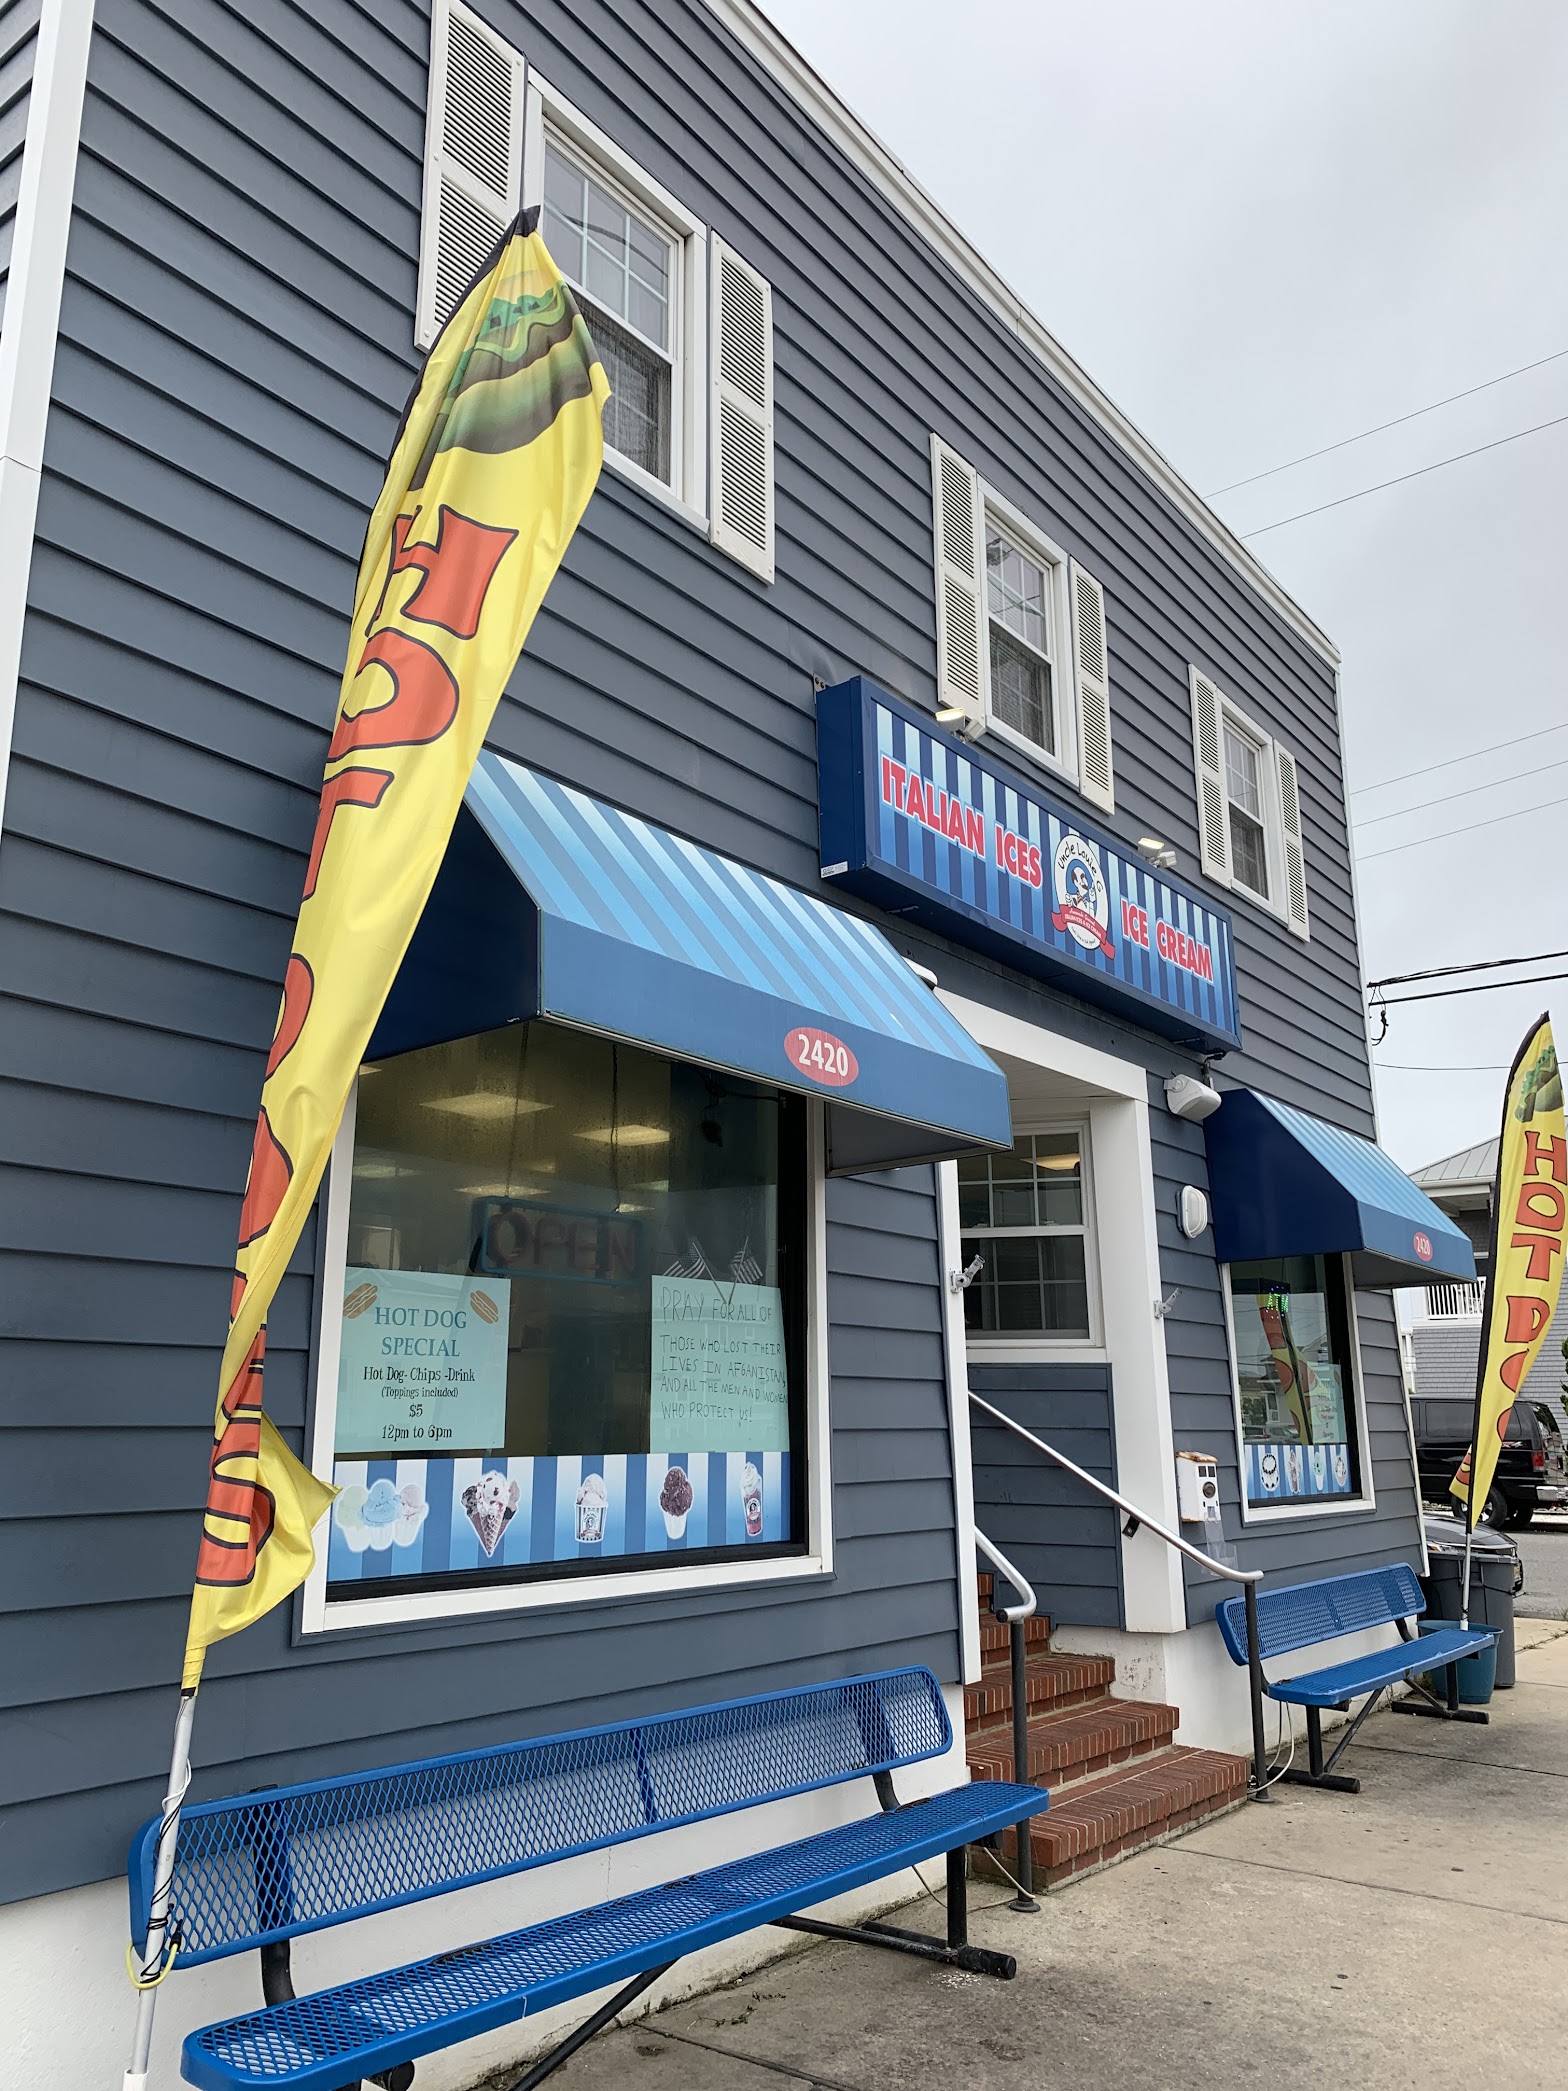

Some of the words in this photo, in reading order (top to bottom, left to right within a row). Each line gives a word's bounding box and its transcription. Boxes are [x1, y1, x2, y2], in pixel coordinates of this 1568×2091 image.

[881, 754, 985, 858] ITALIAN
[995, 823, 1042, 889] ICES
[1057, 841, 1076, 869] Uncle
[1077, 842, 1097, 876] Louie
[1096, 880, 1103, 892] G
[1121, 898, 1150, 950] ICE
[1156, 920, 1213, 984] CREAM
[798, 1033, 848, 1077] 2420
[1510, 1130, 1568, 1281] HOT
[487, 1211, 635, 1273] OPEN
[1415, 1236, 1430, 1255] 2420
[661, 1286, 704, 1324] PRAY
[713, 1298, 734, 1321] FOR
[737, 1304, 756, 1321] ALL
[760, 1306, 772, 1321] OF
[1267, 1293, 1289, 1312] ATM
[374, 1306, 419, 1327] HOT
[423, 1309, 467, 1329] DOG
[381, 1336, 461, 1357] SPECIAL
[660, 1334, 695, 1353] THOSE
[700, 1337, 720, 1353] WHO
[723, 1340, 748, 1353] LOST
[752, 1342, 781, 1355] THEIR
[363, 1366, 383, 1381] Hot
[410, 1366, 441, 1384] Chips
[662, 1355, 699, 1372] LIVES
[702, 1361, 721, 1374] IN
[381, 1386, 419, 1399] (Toppings
[422, 1387, 458, 1398] included)
[660, 1375, 680, 1392] AND
[683, 1378, 697, 1392] ALL
[700, 1380, 718, 1393] THE
[721, 1383, 740, 1395] MEN
[742, 1385, 760, 1400] AND
[763, 1390, 788, 1404] WOMEN
[409, 1403, 423, 1418] $5
[661, 1401, 685, 1420] WHO
[689, 1401, 734, 1418] PROTECT
[739, 1405, 752, 1422] US!
[382, 1424, 409, 1442] 12pm
[413, 1426, 424, 1438] to
[428, 1424, 452, 1441] 6pm
